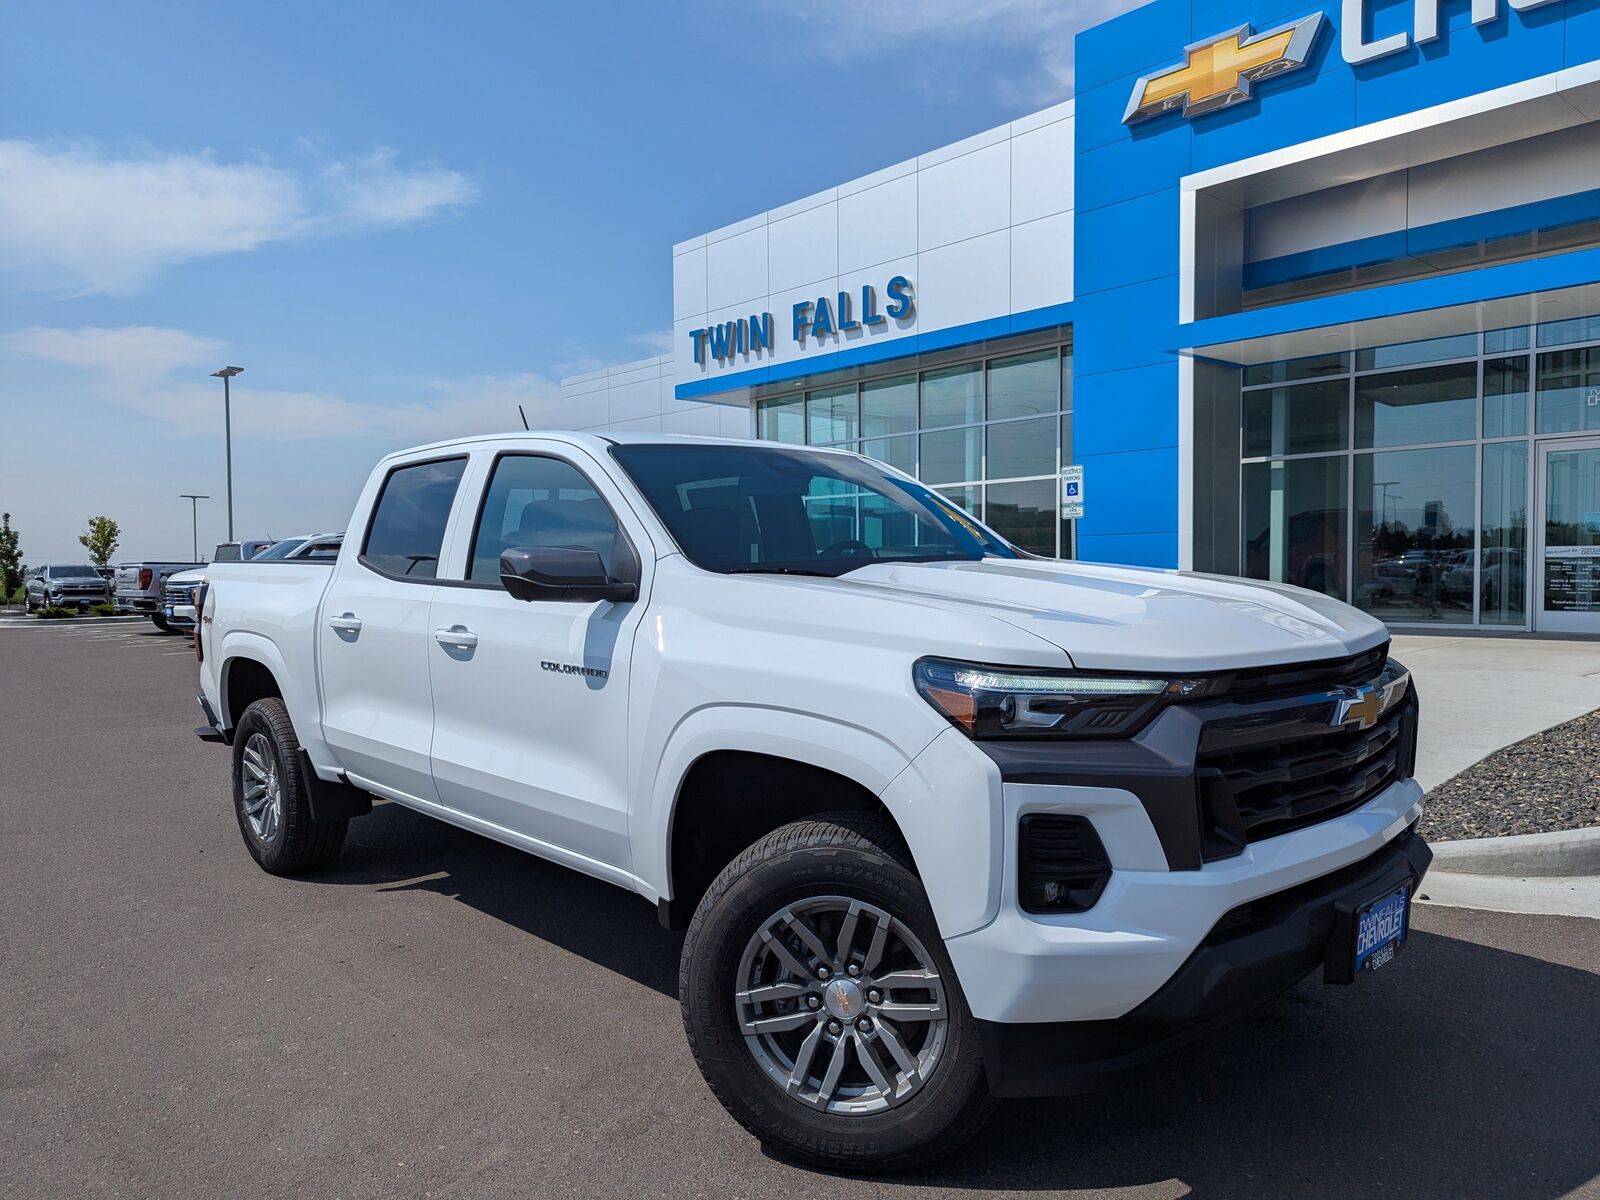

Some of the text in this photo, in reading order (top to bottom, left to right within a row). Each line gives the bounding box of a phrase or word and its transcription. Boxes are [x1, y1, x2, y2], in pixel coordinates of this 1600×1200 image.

[689, 275, 914, 364] TWIN FALLS
[540, 660, 607, 679] COLORADO
[1356, 907, 1404, 956] CHEVROLET
